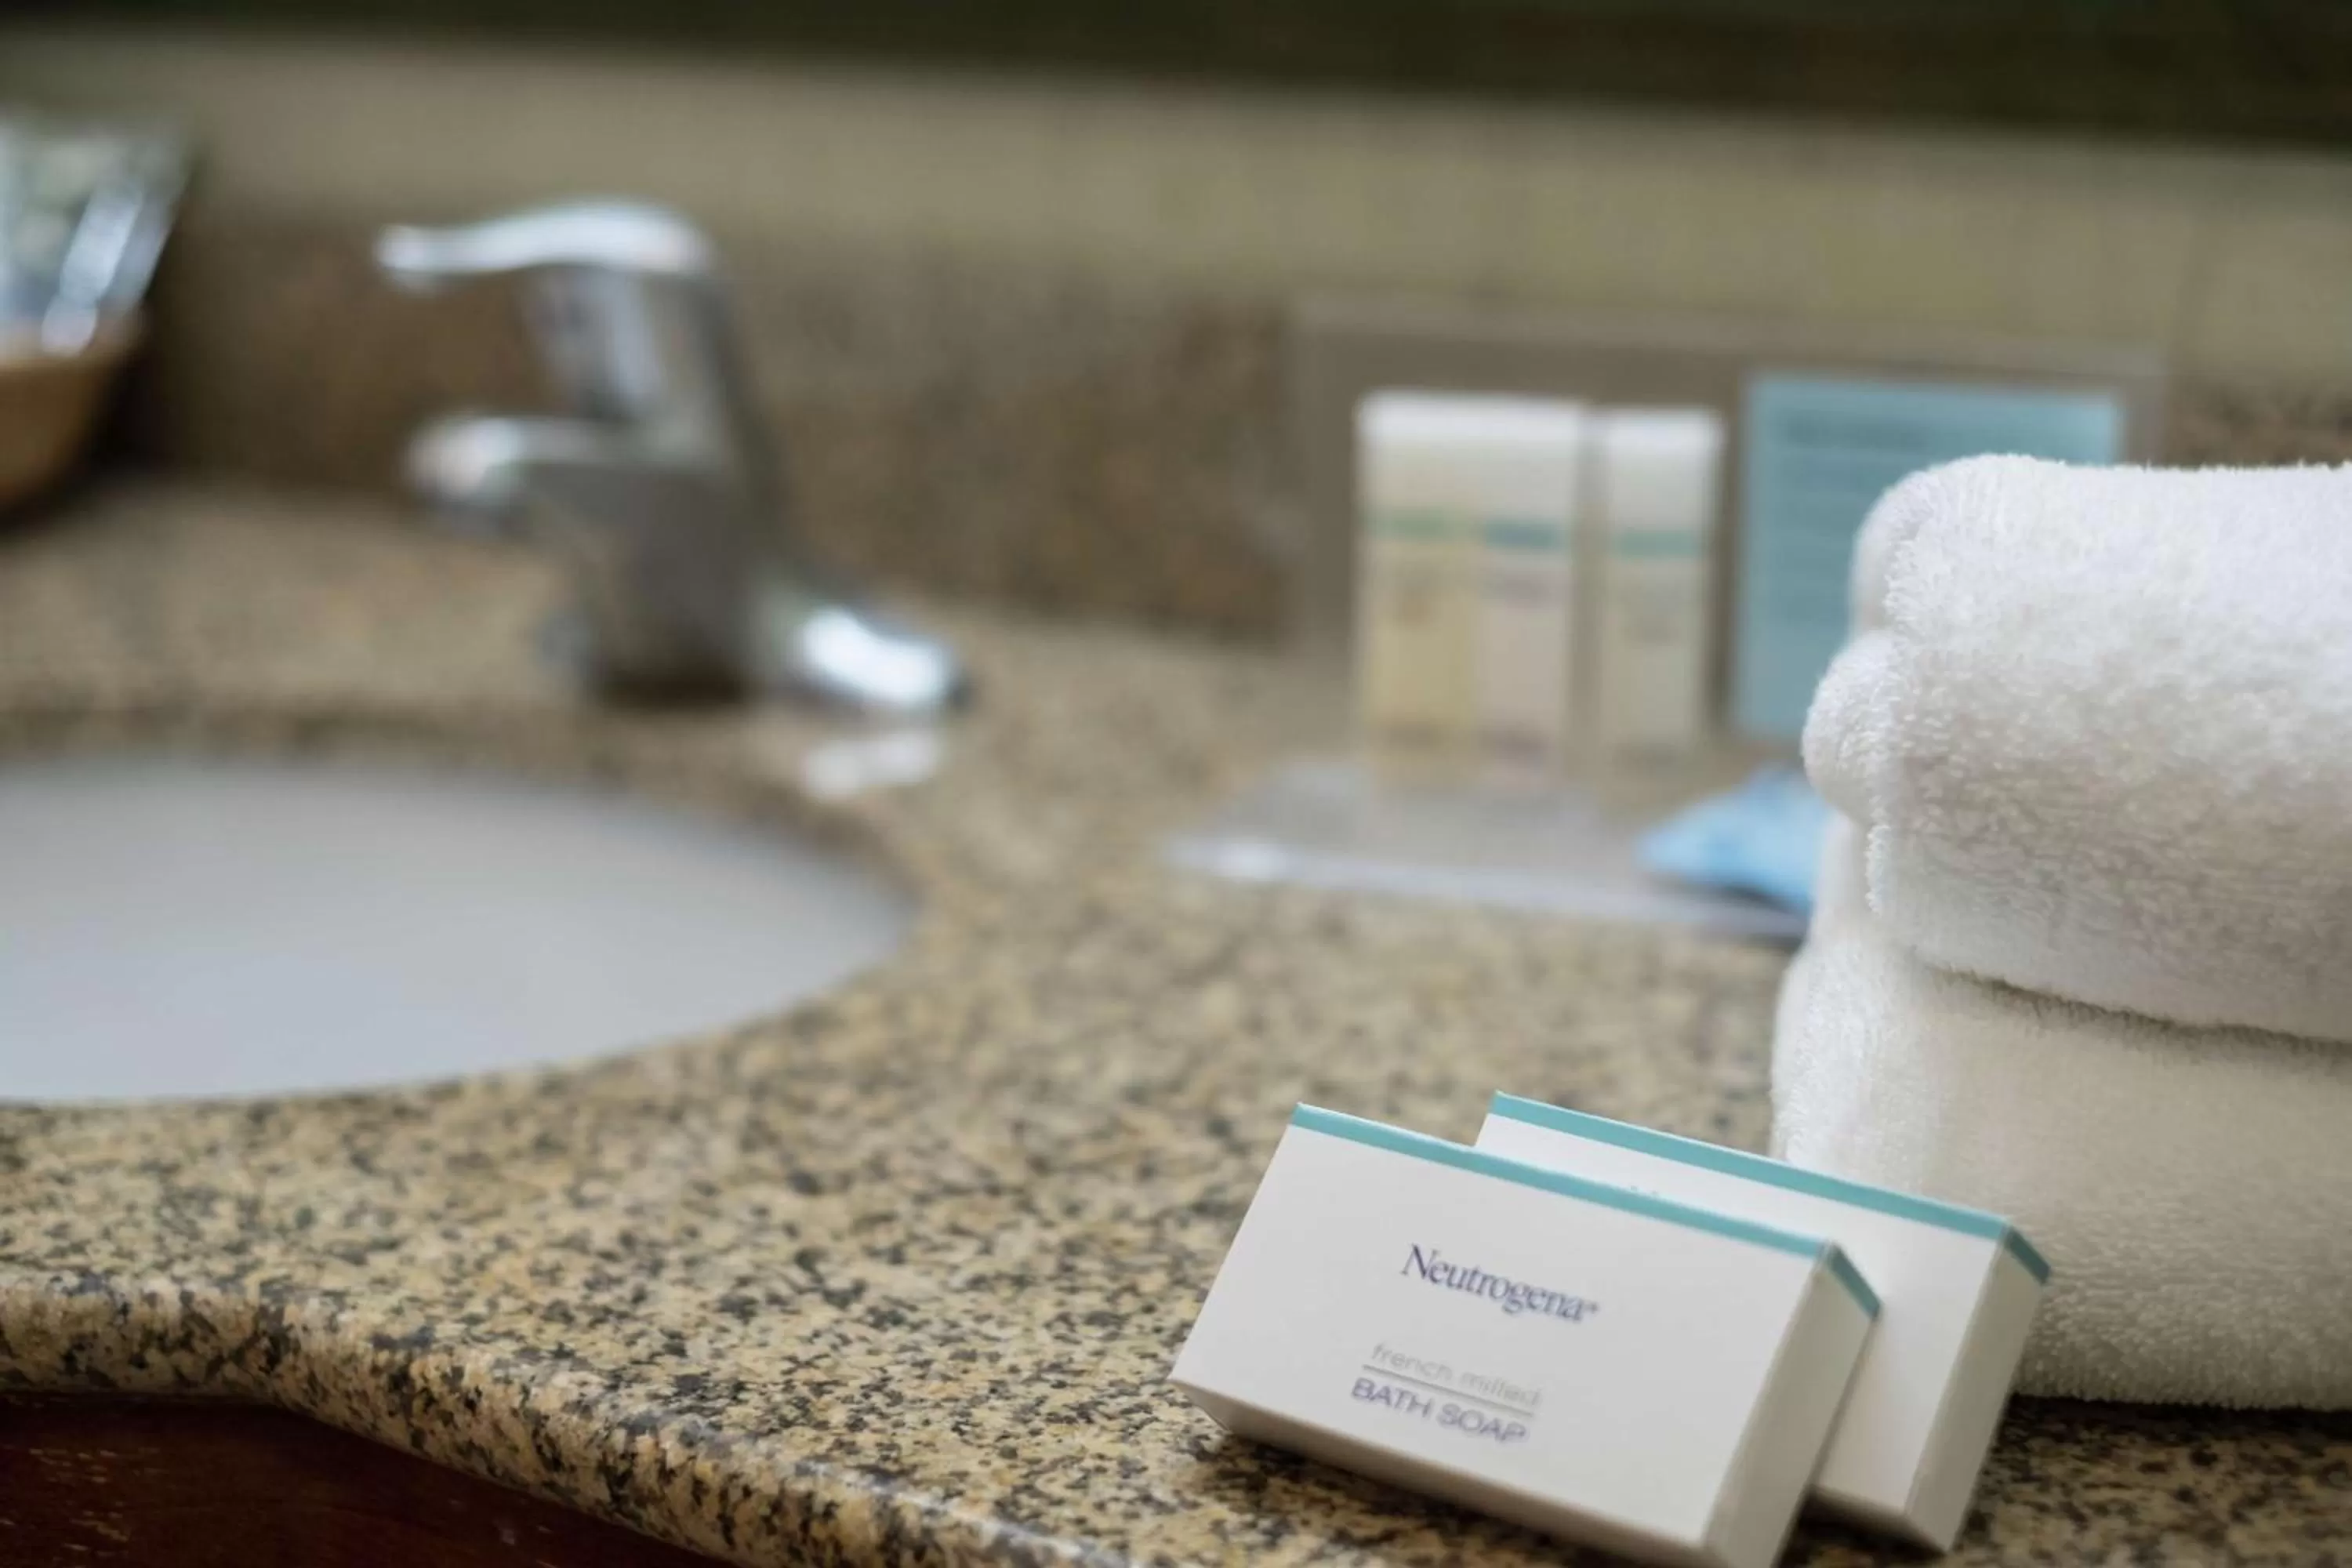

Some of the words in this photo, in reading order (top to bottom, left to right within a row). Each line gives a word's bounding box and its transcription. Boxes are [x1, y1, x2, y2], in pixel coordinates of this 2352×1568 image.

[1399, 1243, 1585, 1323] Neutrogena
[1351, 1377, 1434, 1417] BATH
[1437, 1403, 1528, 1442] SOAP
